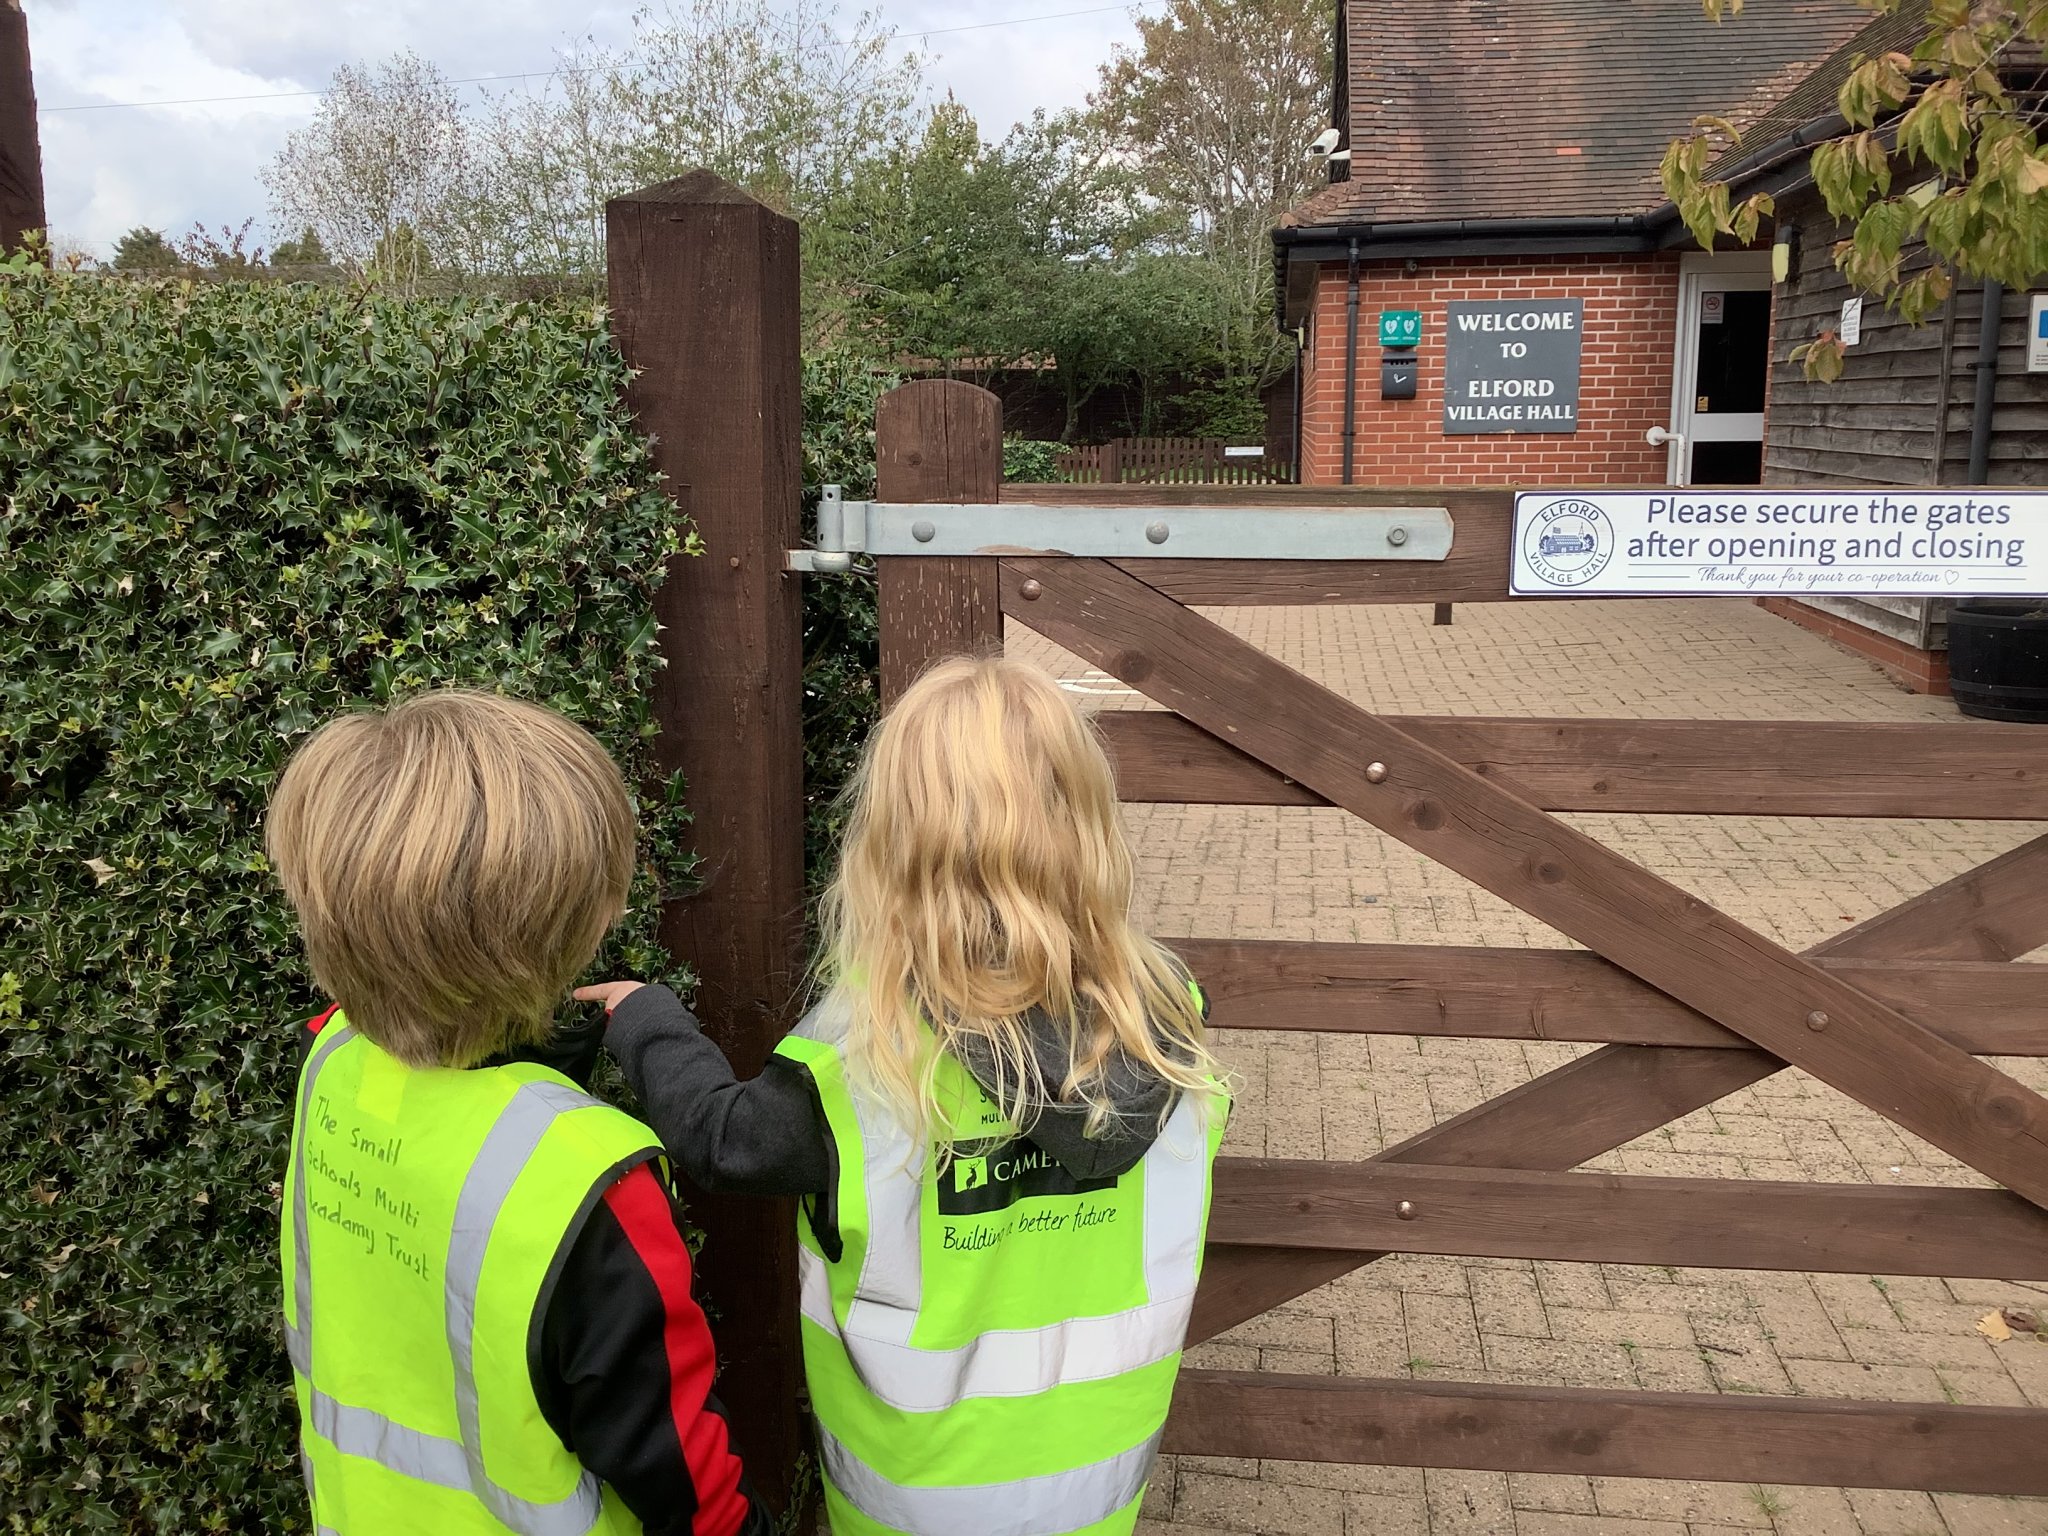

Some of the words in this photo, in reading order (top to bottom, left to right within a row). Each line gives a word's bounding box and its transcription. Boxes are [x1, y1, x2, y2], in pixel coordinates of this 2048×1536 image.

[1457, 312, 1575, 331] WELCOME
[1500, 342, 1527, 358] TO
[1468, 379, 1555, 398] ELFORD
[1447, 405, 1523, 421] VILLAGE
[1527, 404, 1574, 420] HALL
[1541, 502, 1600, 523] ELFORD
[1647, 497, 1748, 523] Please
[1755, 503, 1859, 524] secure
[1868, 497, 1918, 524] the
[1925, 500, 2011, 531] gates
[1627, 531, 1700, 557] after
[1708, 532, 1836, 566] opening
[1845, 531, 1902, 558] and
[1912, 531, 2025, 566] closing
[1530, 552, 1573, 583] VILLAGE
[1581, 552, 1608, 578] HALL
[1698, 566, 1748, 585] Thank
[1746, 572, 1778, 589] you
[1778, 567, 1805, 588] for
[1805, 572, 1844, 589] your
[1847, 569, 1940, 589] co-operation
[315, 1095, 337, 1135] The
[350, 1128, 402, 1166] Small
[981, 1112, 1005, 1125] MUL
[993, 1150, 1061, 1181] CAME
[308, 1141, 361, 1198] Schools
[375, 1187, 420, 1228] Multi
[1018, 1209, 1069, 1233] better
[1072, 1202, 1117, 1232] future
[386, 1232, 429, 1281] Trust
